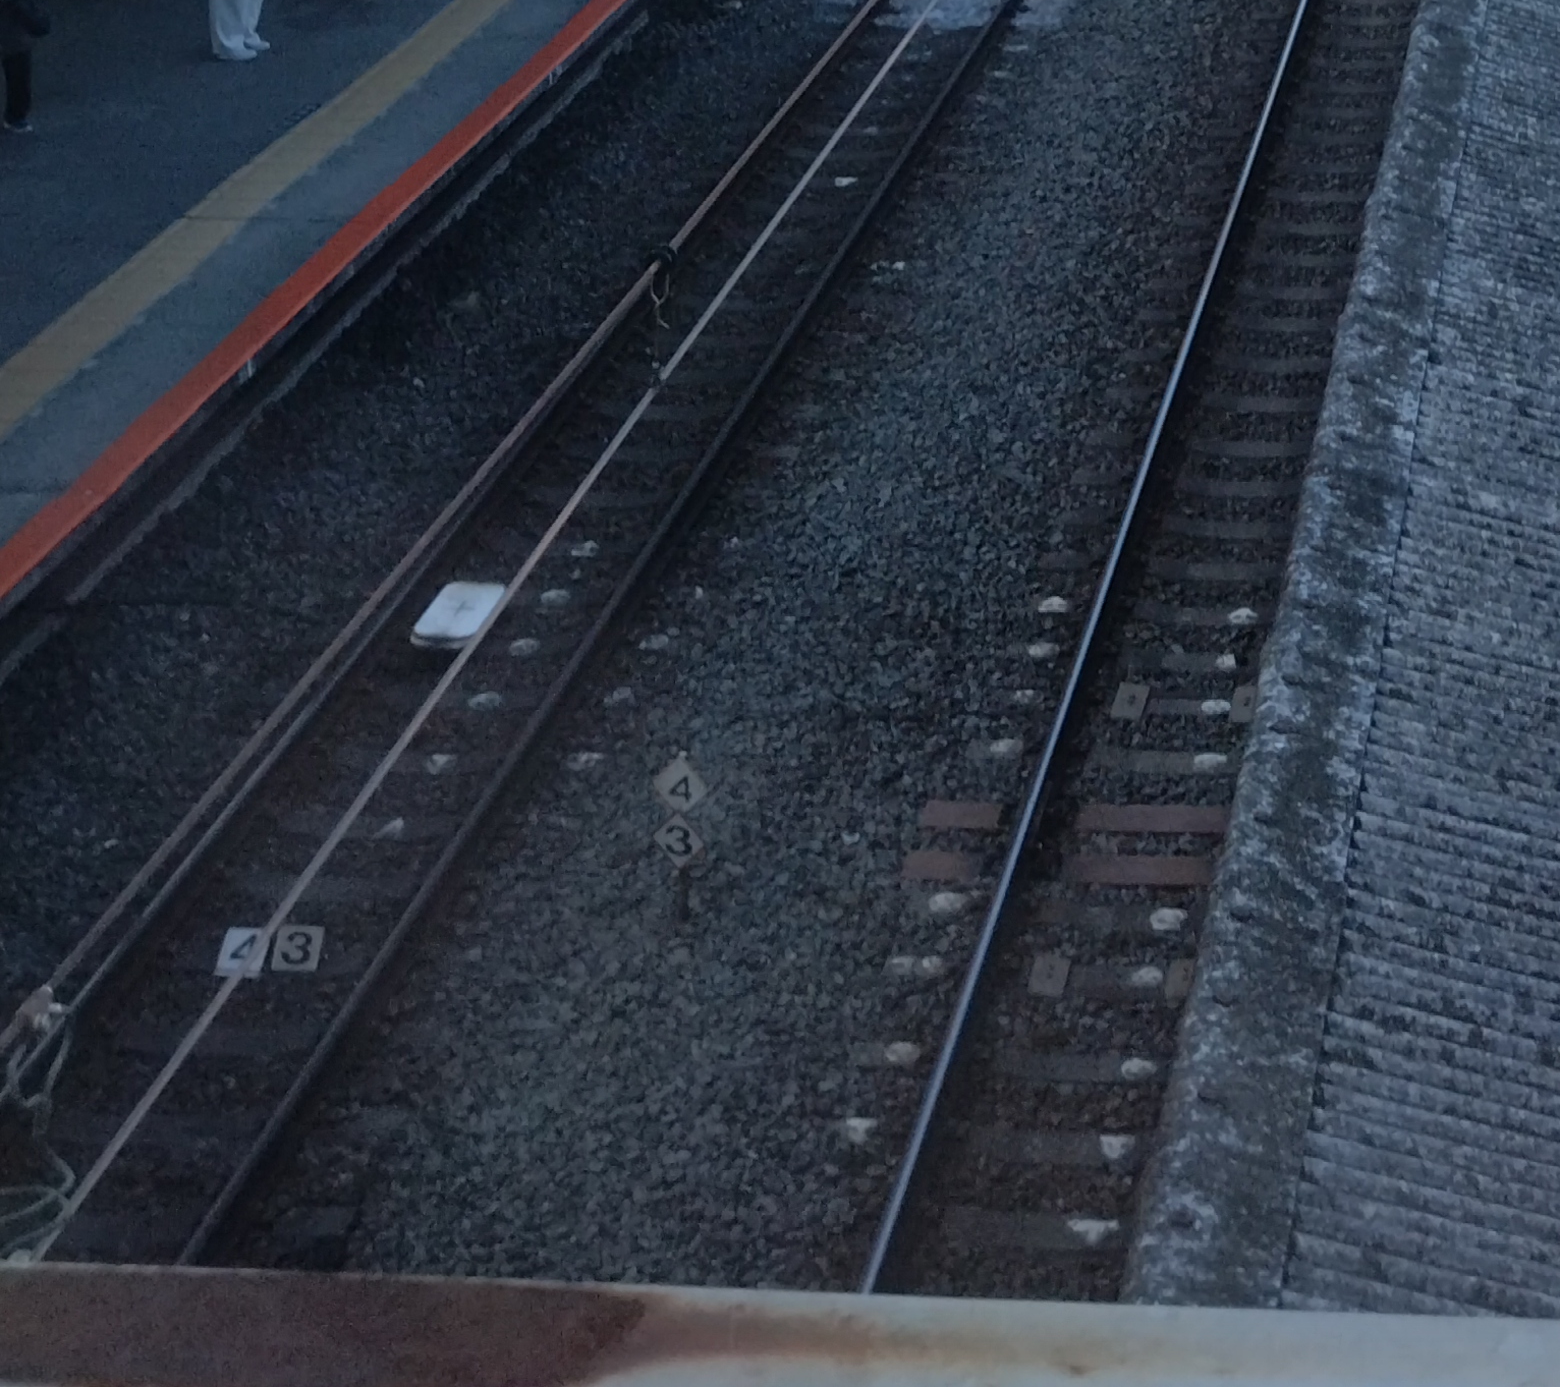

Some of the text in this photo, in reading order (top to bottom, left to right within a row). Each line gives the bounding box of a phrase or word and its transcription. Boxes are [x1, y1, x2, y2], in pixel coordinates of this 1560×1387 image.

[668, 776, 692, 802] 4
[665, 825, 692, 857] 3
[228, 931, 313, 965] 4 3
